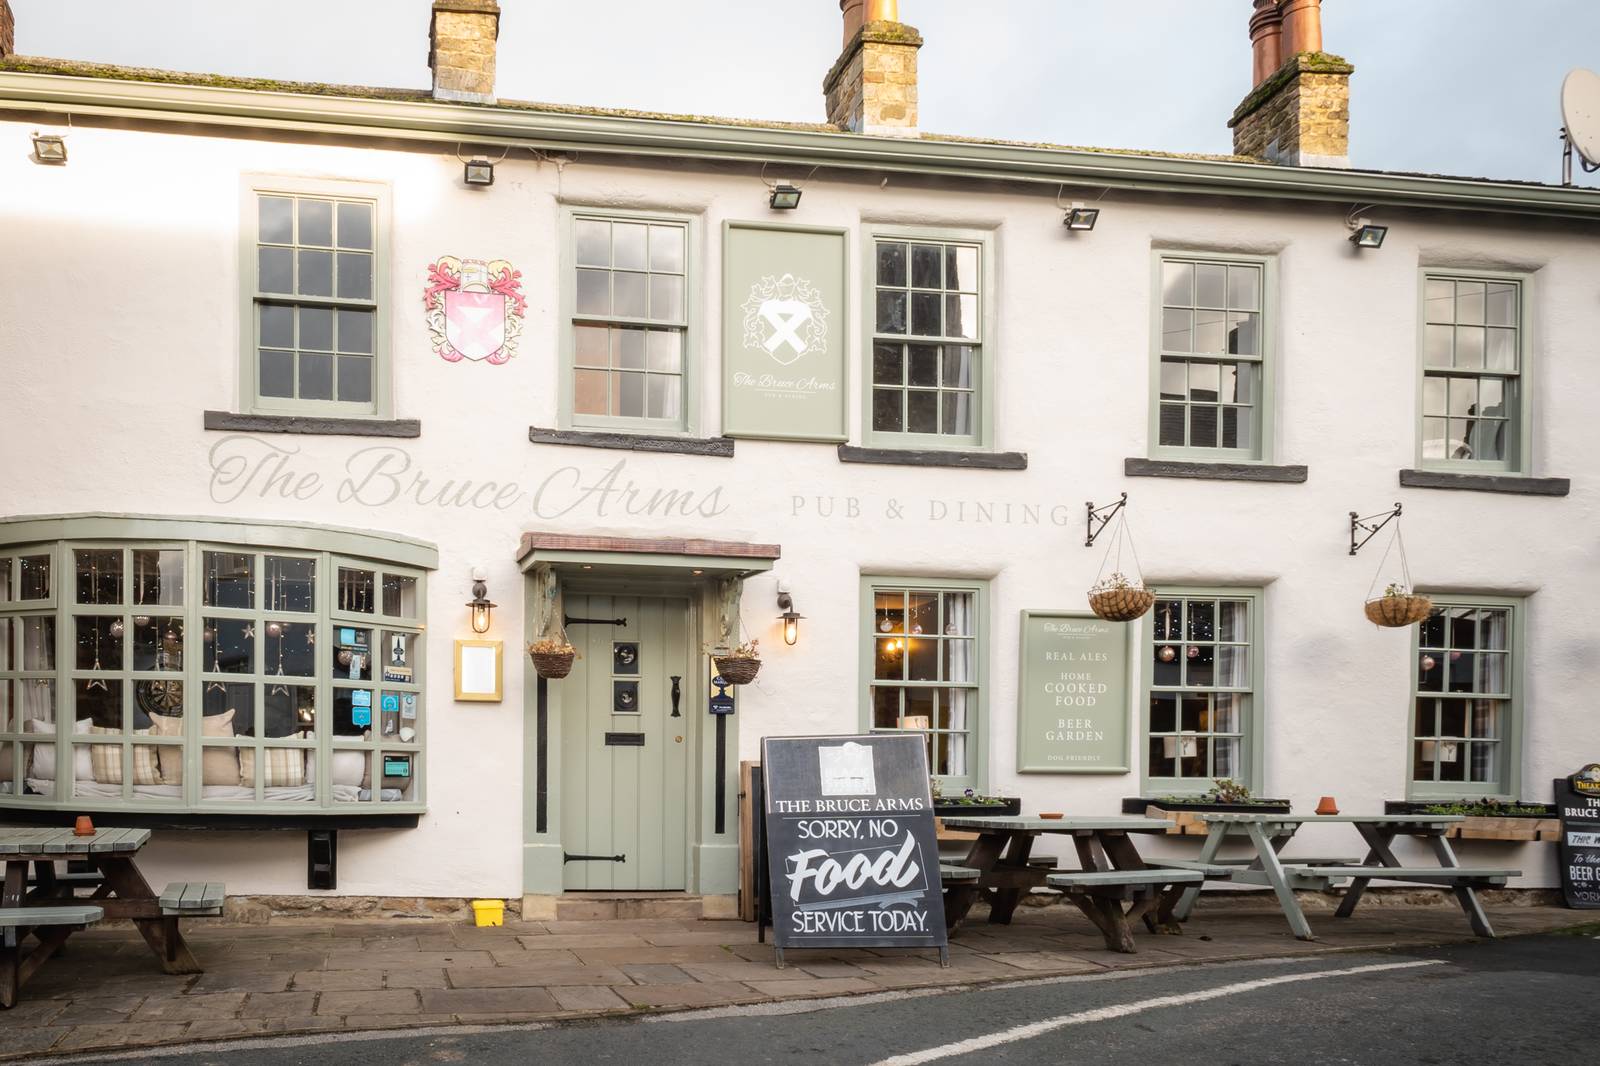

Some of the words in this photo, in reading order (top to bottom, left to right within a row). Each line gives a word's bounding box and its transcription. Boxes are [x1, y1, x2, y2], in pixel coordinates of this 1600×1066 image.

[207, 434, 322, 504] The
[337, 445, 521, 509] Bruce
[532, 456, 730, 520] Arms
[791, 495, 861, 518] PUB
[885, 498, 904, 519] &
[928, 499, 1068, 526] DINING
[1045, 651, 1075, 661] REAL
[1079, 651, 1108, 662] ALES
[1060, 671, 1092, 681] HOME
[1044, 682, 1107, 694] COOKED
[1055, 695, 1096, 706] FOOD
[1058, 719, 1093, 729] BEER
[1045, 730, 1104, 741] GARDEN
[776, 800, 811, 813] THE
[815, 799, 871, 812] BRUCE
[875, 798, 924, 811] ARMS
[1564, 807, 1599, 818] BRUCE
[798, 820, 865, 840] SORRY,
[869, 819, 899, 838] NO
[785, 829, 920, 902] Food
[1569, 865, 1594, 881] BEER
[791, 910, 866, 933] SERVICE
[867, 910, 929, 932] TODAY.
